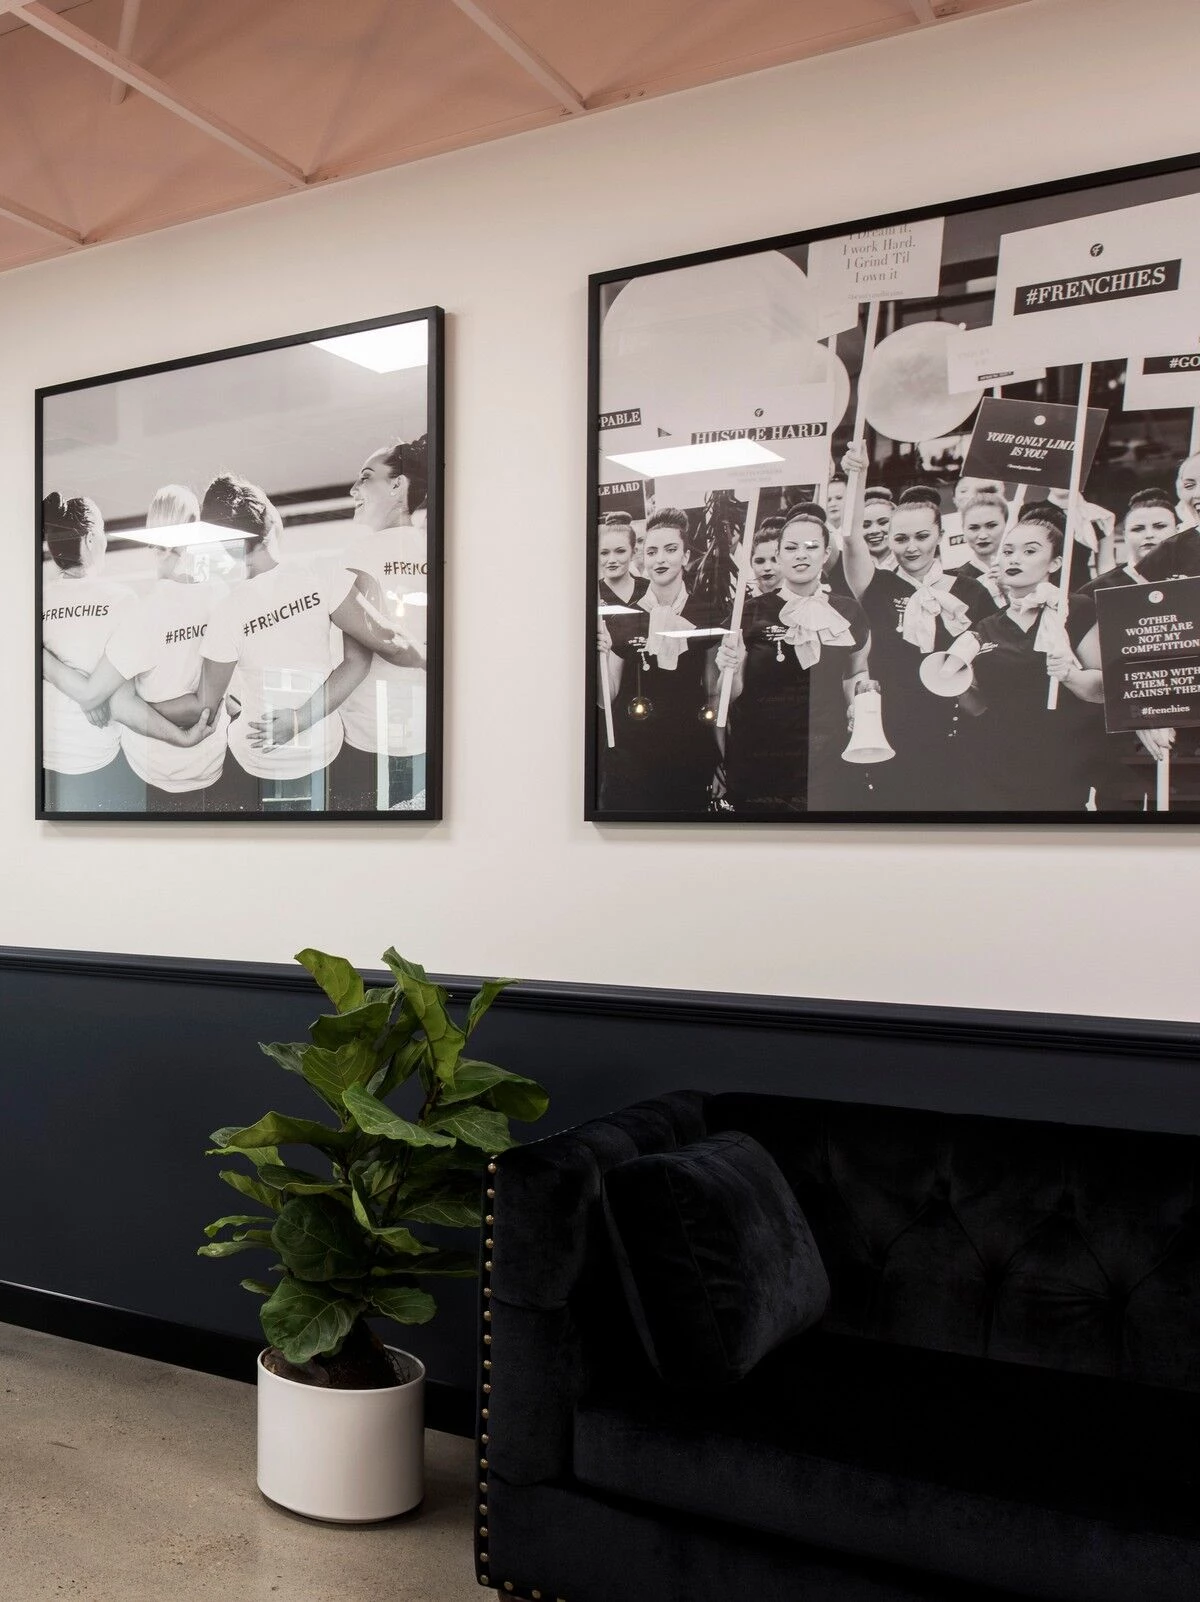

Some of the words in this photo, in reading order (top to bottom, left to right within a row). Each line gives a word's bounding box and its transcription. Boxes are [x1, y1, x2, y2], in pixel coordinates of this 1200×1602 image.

[851, 240, 879, 254] work
[883, 235, 916, 251] Hard.
[854, 253, 888, 268] Grind
[892, 251, 910, 265] Til
[862, 272, 886, 282] own
[1025, 266, 1167, 306] #FRENCHIES
[770, 422, 824, 441] HARD
[985, 431, 1015, 444] YOUR
[1015, 434, 1048, 448] ONLY
[1046, 438, 1077, 451] LIMI
[1010, 446, 1023, 457] IS
[612, 481, 641, 495] HARD
[243, 592, 322, 637] #FRENCHIES
[1138, 614, 1178, 626] OTHER
[1126, 625, 1168, 637] WOMEN
[1170, 621, 1194, 632] ARE
[1138, 633, 1162, 645] NOT
[1164, 631, 1181, 642] MY
[1131, 669, 1168, 681] STAND
[1170, 666, 1200, 677] WITH
[1133, 678, 1168, 690] THEM,
[1170, 676, 1195, 686] NOT
[1123, 687, 1171, 700] AGAINST
[1174, 685, 1200, 695] THE
[1141, 704, 1190, 716] #frenchies
